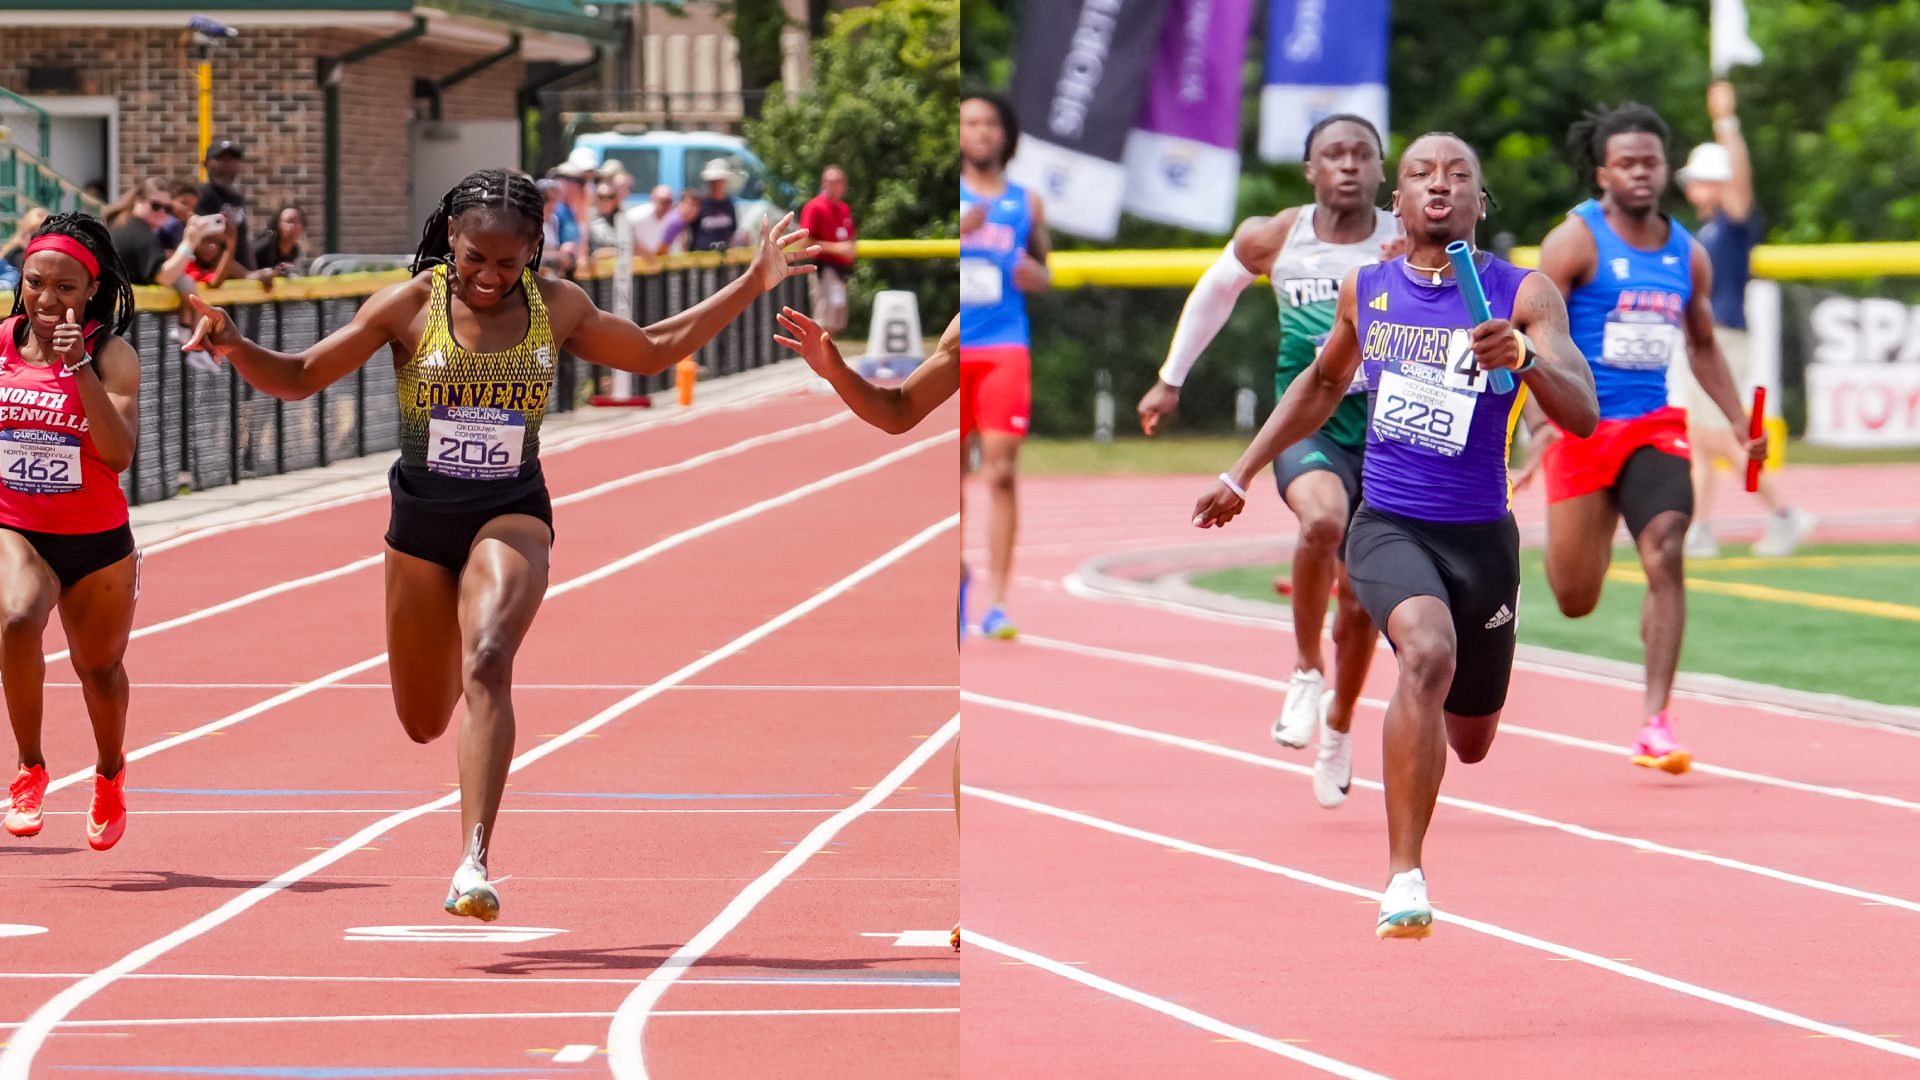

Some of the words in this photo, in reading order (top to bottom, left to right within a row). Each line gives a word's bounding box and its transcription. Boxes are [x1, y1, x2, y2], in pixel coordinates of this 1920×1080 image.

[1363, 320, 1454, 365] CONVER
[1400, 363, 1446, 384] CAROLIN
[1454, 346, 1481, 387] 4
[0, 387, 69, 409] NORTH
[1402, 389, 1446, 407] CONVERSE
[447, 408, 510, 421] CAROLINAS
[460, 406, 501, 414] CONFERENCE
[1383, 394, 1454, 437] 228
[13, 431, 67, 443] CAROLINAS
[455, 431, 498, 440] CONVERSE
[456, 424, 497, 433] OKODUWA
[20, 444, 56, 452] ROBINSON
[438, 437, 510, 465] 206
[8, 457, 69, 482] 462
